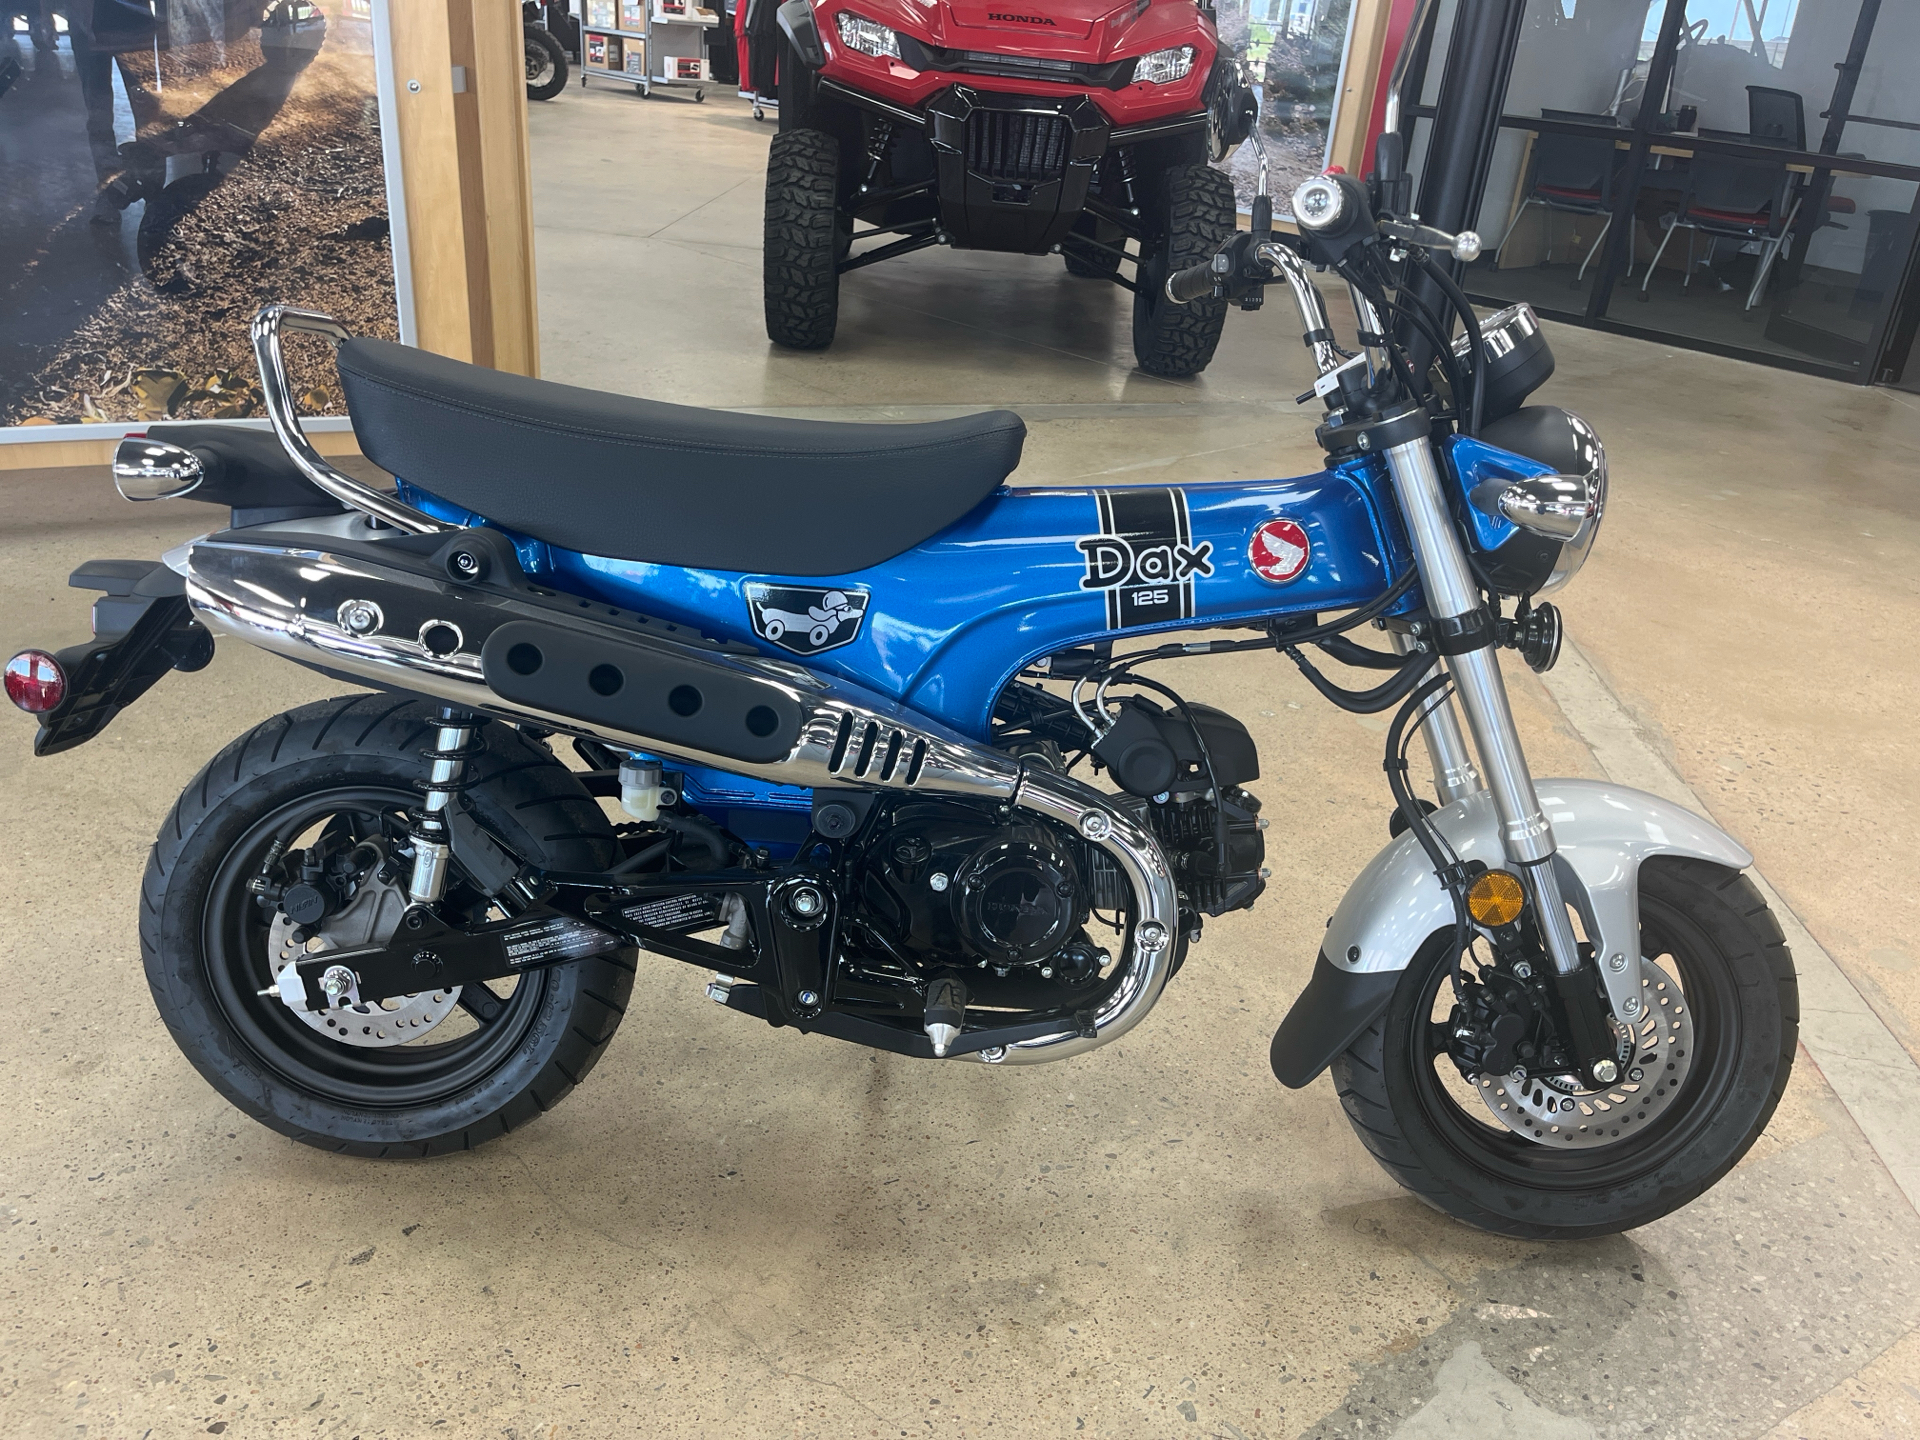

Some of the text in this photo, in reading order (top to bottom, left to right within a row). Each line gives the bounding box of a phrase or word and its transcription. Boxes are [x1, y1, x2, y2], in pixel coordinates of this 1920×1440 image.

[988, 13, 1057, 26] HONDA
[1075, 534, 1215, 592] Dax
[1132, 590, 1169, 606] 125
